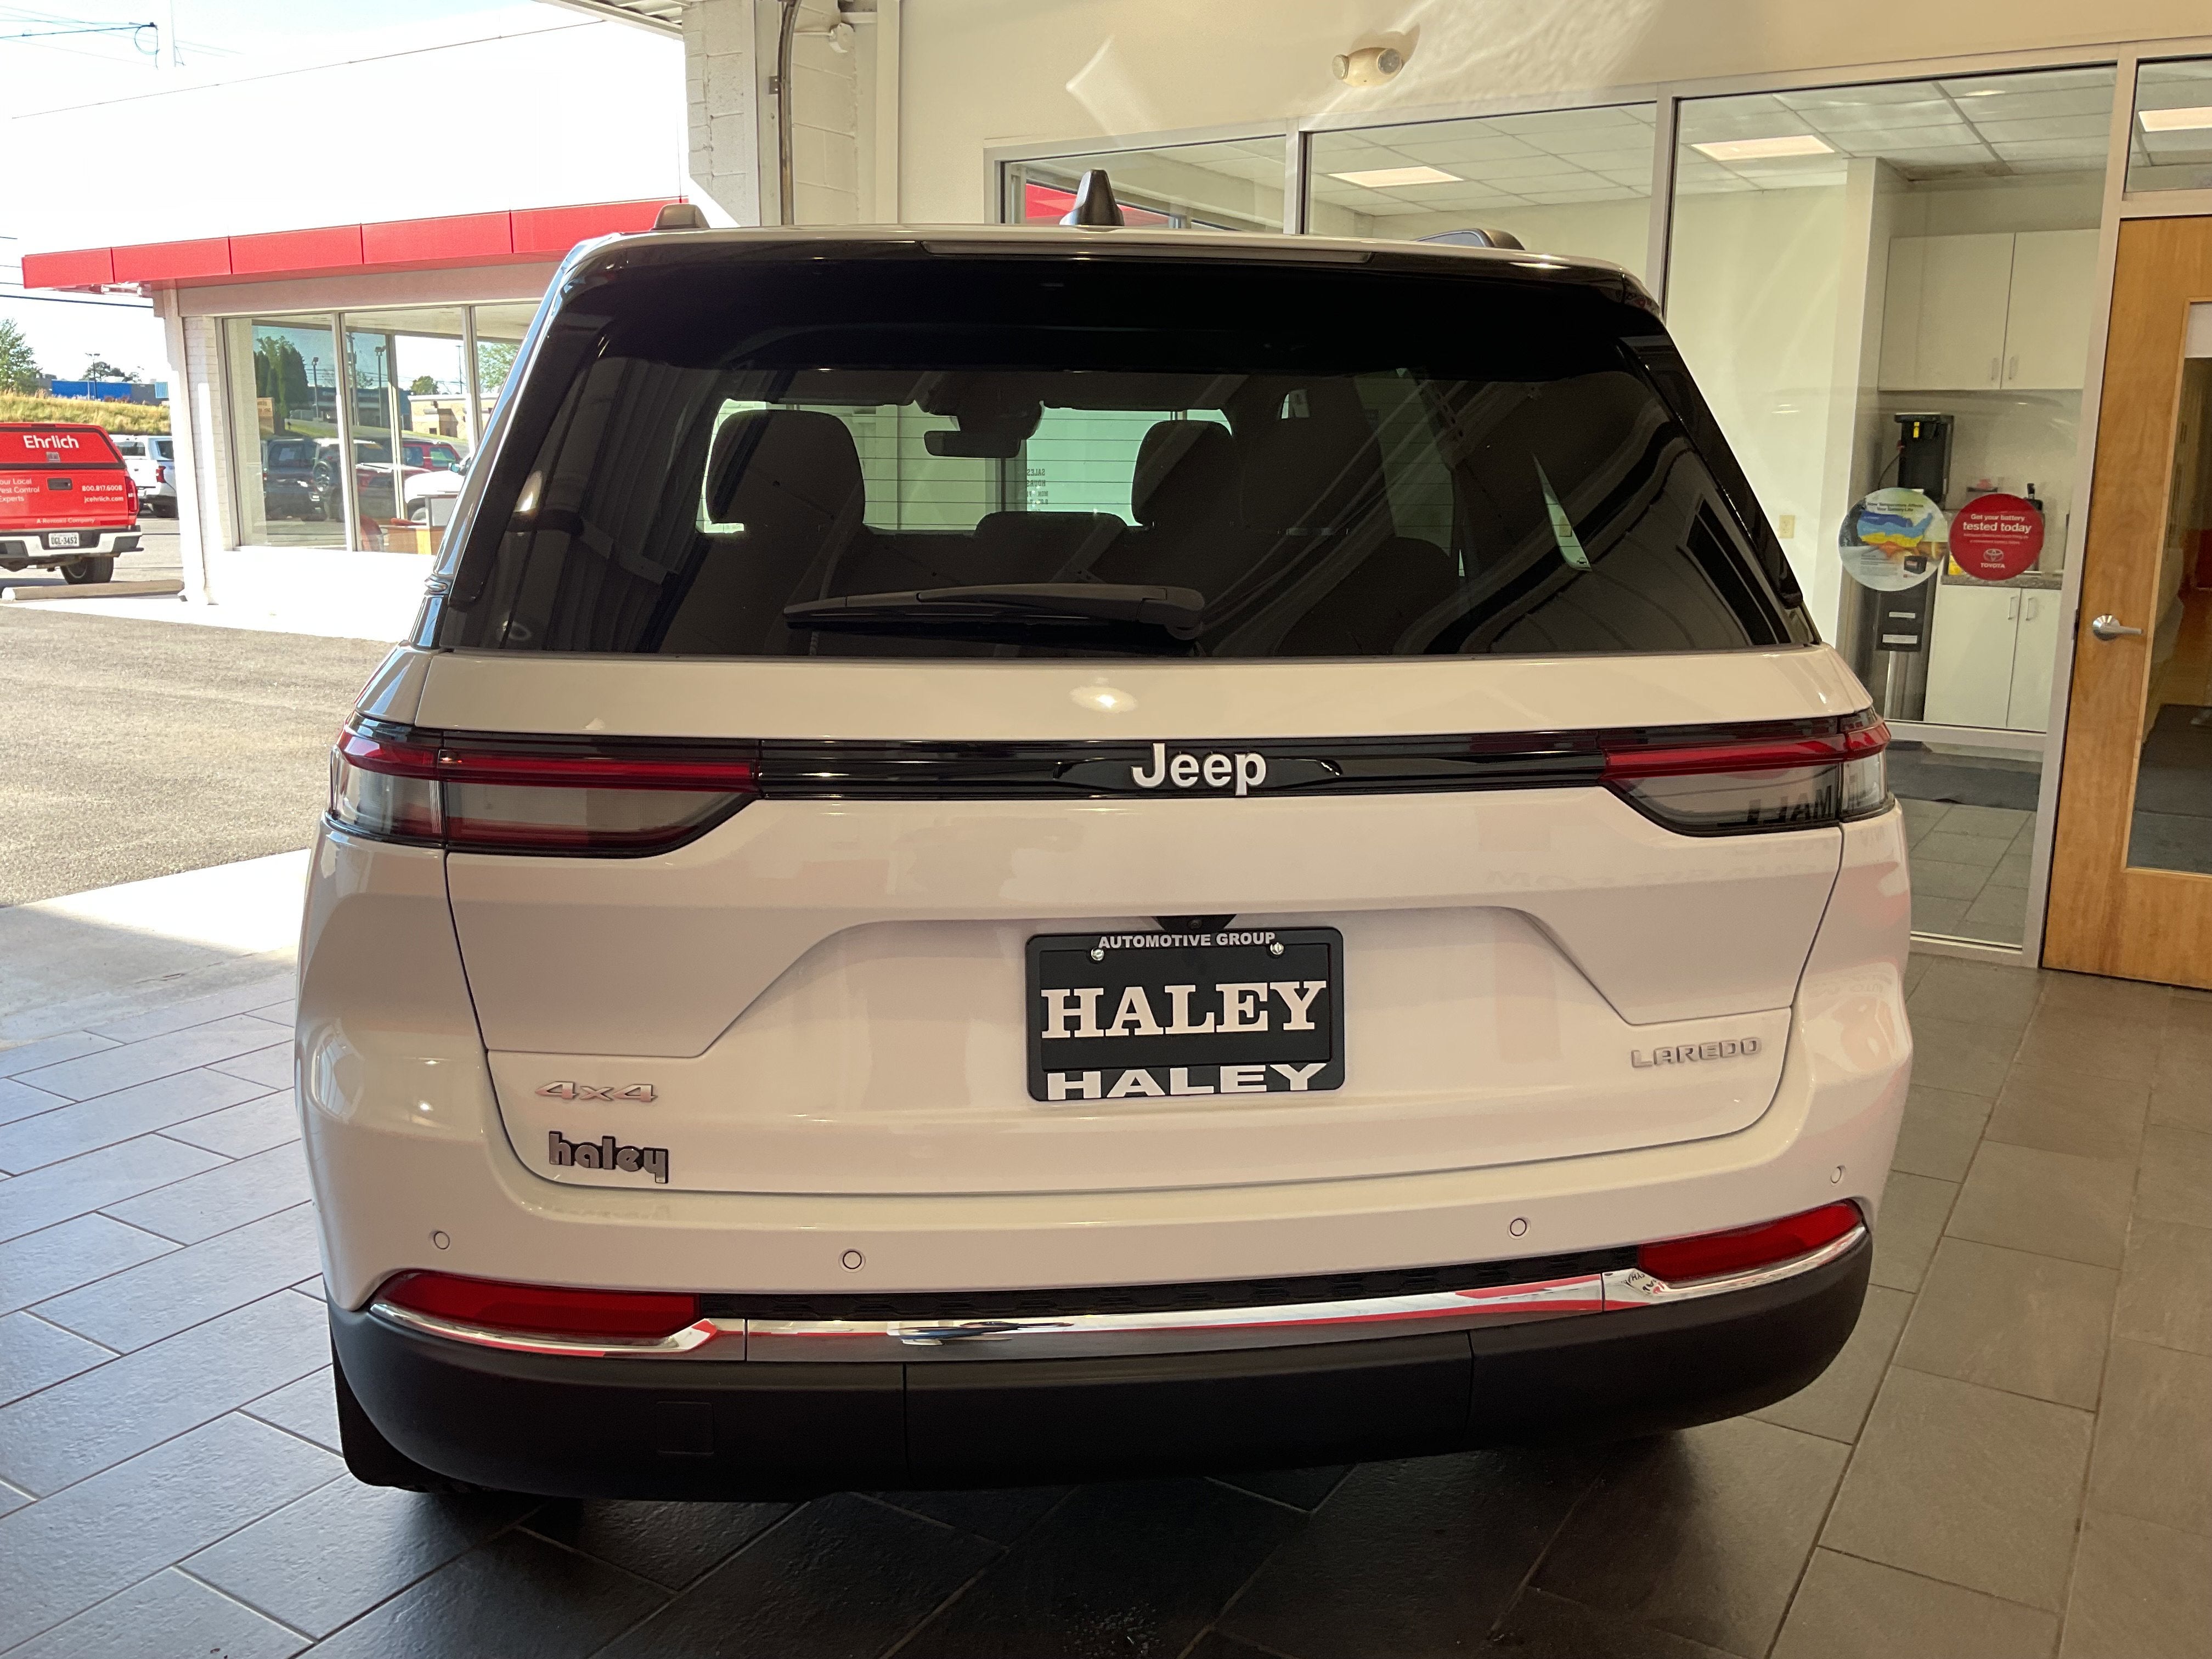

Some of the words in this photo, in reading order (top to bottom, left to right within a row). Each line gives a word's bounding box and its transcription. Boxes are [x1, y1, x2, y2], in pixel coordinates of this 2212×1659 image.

[23, 435, 80, 448] Ehrlich
[1963, 522, 1997, 531] tested
[2000, 523, 2032, 534] today
[1131, 742, 1266, 795] Jeep
[1098, 934, 1211, 949] AUTOMOTIVE
[1216, 932, 1276, 946] GROUP
[1041, 980, 1327, 1038] HALEY
[1631, 1037, 1761, 1068] LAREDO
[535, 1081, 658, 1102] 4x4
[1047, 1063, 1327, 1101] HALEY
[549, 1131, 668, 1183] haley
